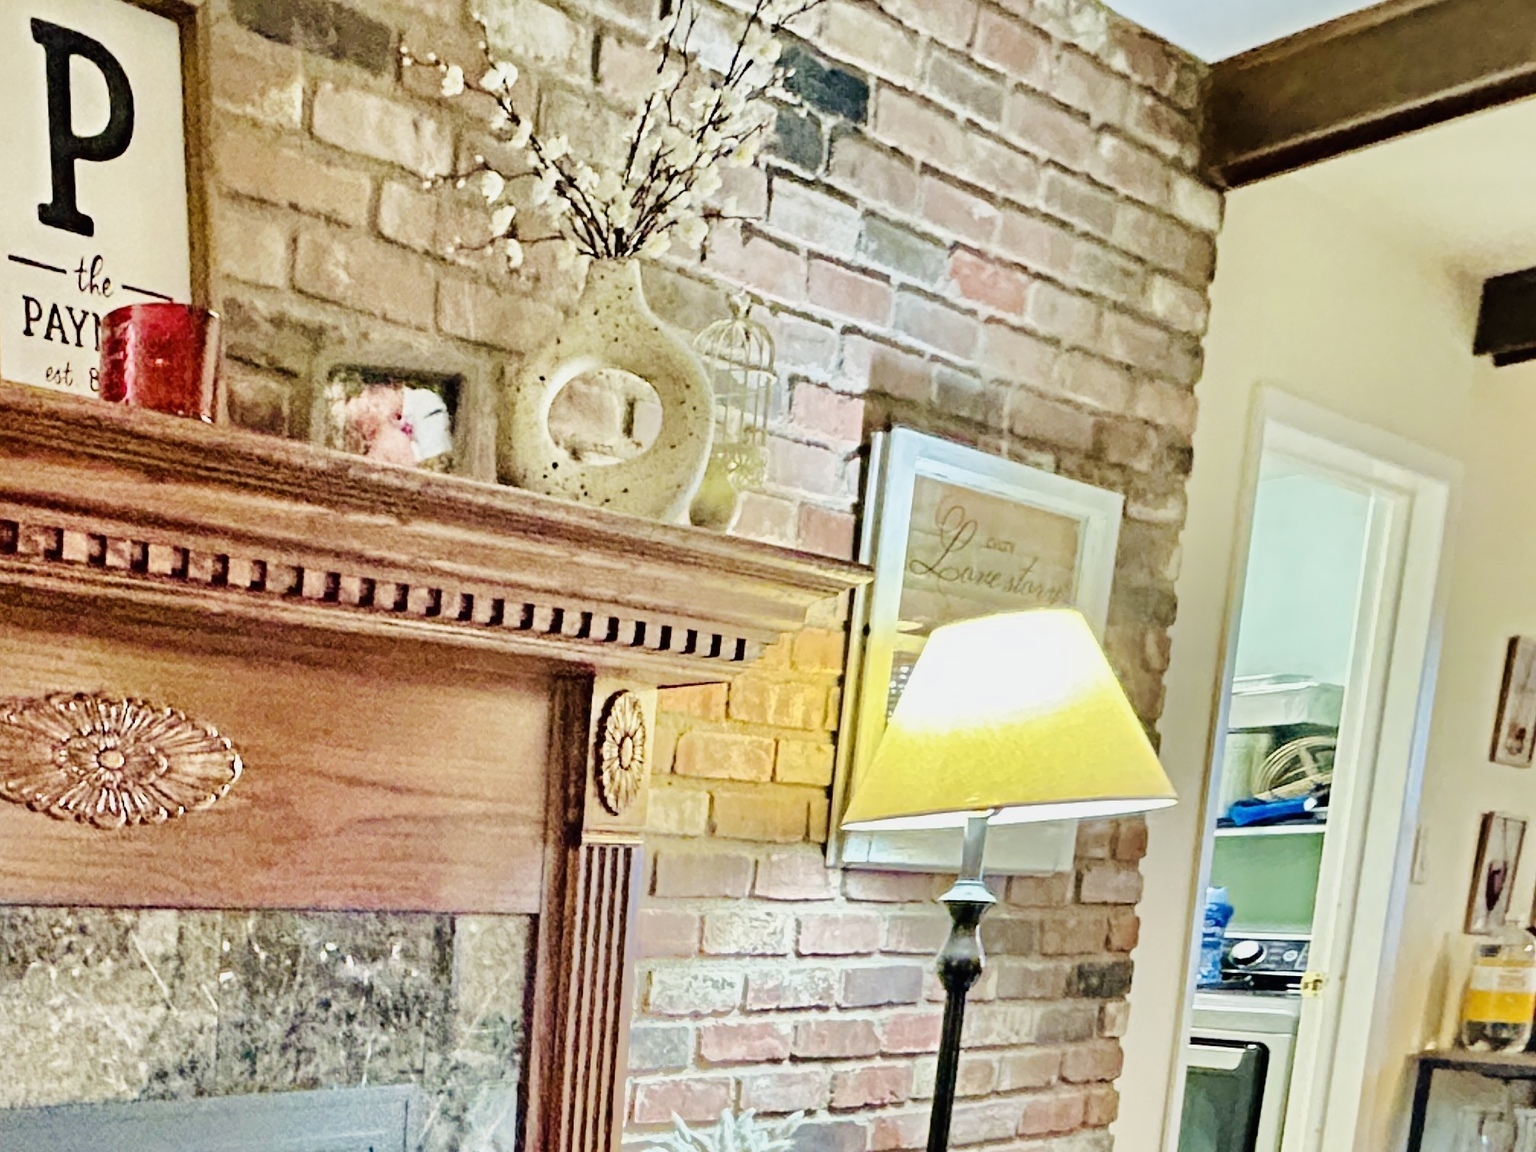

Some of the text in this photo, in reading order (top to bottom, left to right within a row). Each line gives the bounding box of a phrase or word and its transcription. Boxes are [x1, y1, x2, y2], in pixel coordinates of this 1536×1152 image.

[30, 17, 135, 237] P
[74, 254, 114, 298] the
[46, 362, 74, 387] est
